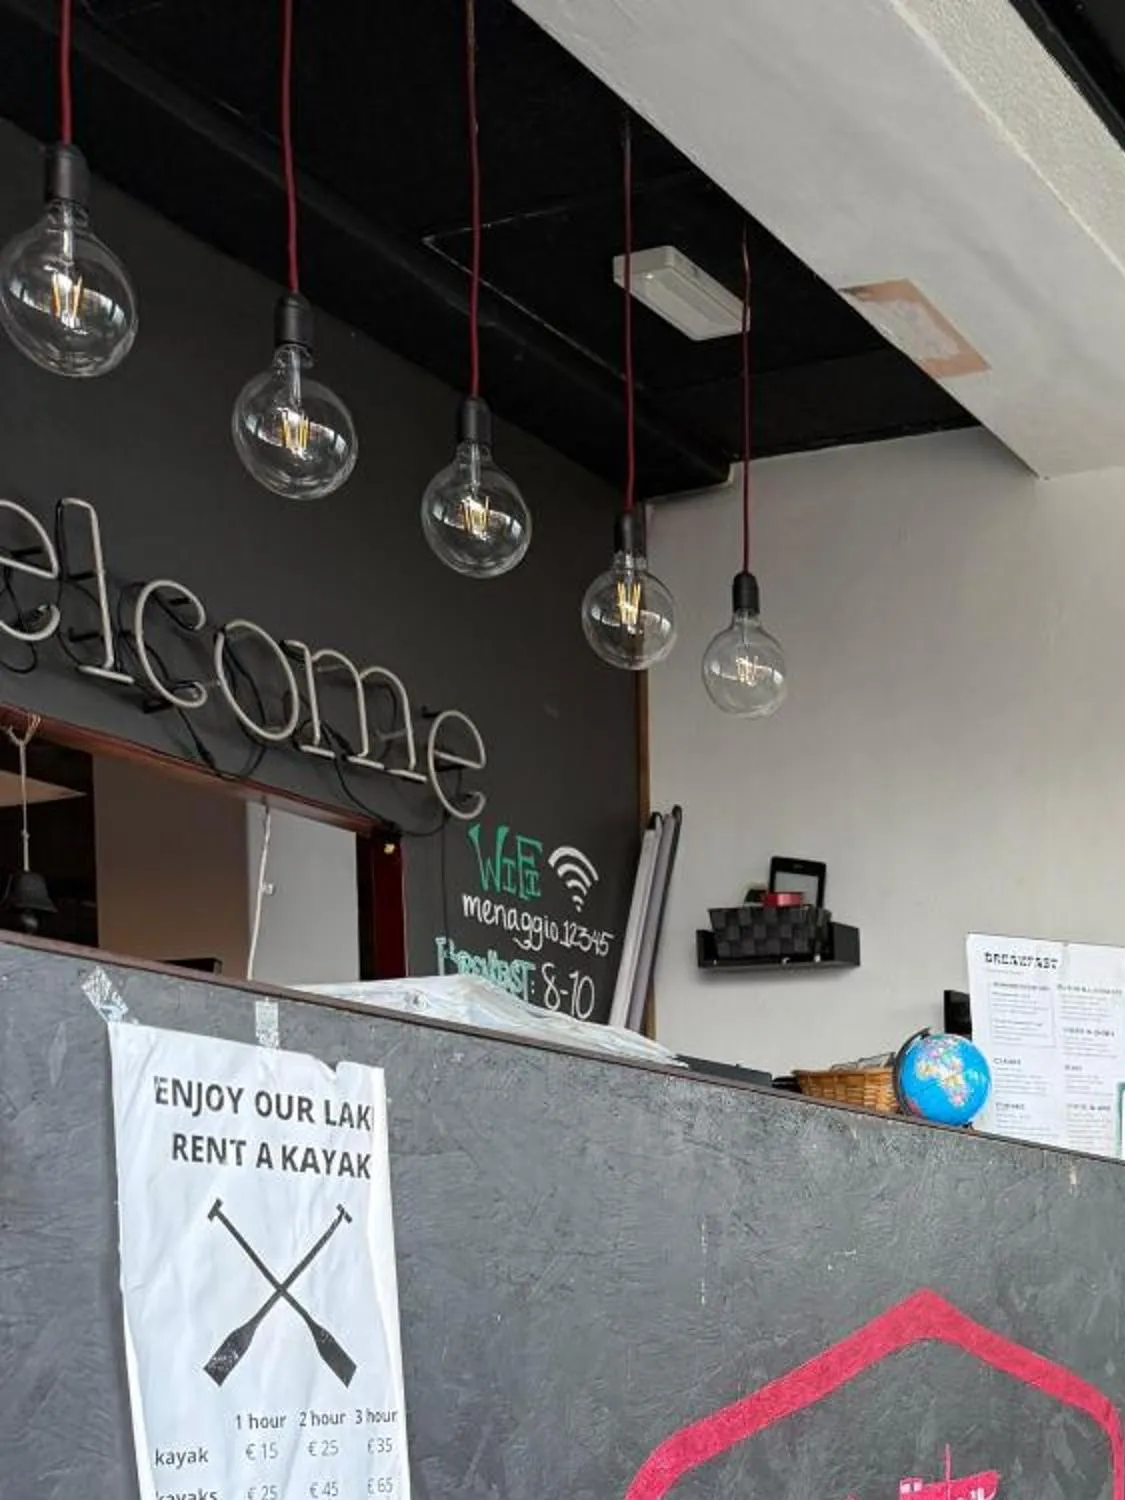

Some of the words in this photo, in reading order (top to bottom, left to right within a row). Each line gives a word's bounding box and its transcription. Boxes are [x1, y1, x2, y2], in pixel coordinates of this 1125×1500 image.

[541, 962, 595, 1019] 8-10
[154, 1076, 244, 1117] ENJOY
[255, 1090, 315, 1123] OUR
[325, 1099, 374, 1132] LAK
[172, 1133, 246, 1166] RENT
[256, 1142, 273, 1169] A
[282, 1145, 371, 1180] KAYAK
[236, 1414, 242, 1430] 1
[248, 1412, 287, 1430] hour
[299, 1411, 307, 1427] 2
[310, 1410, 346, 1427] hour
[355, 1409, 363, 1424] 3
[366, 1408, 398, 1424] hour
[155, 1448, 208, 1469] kayak
